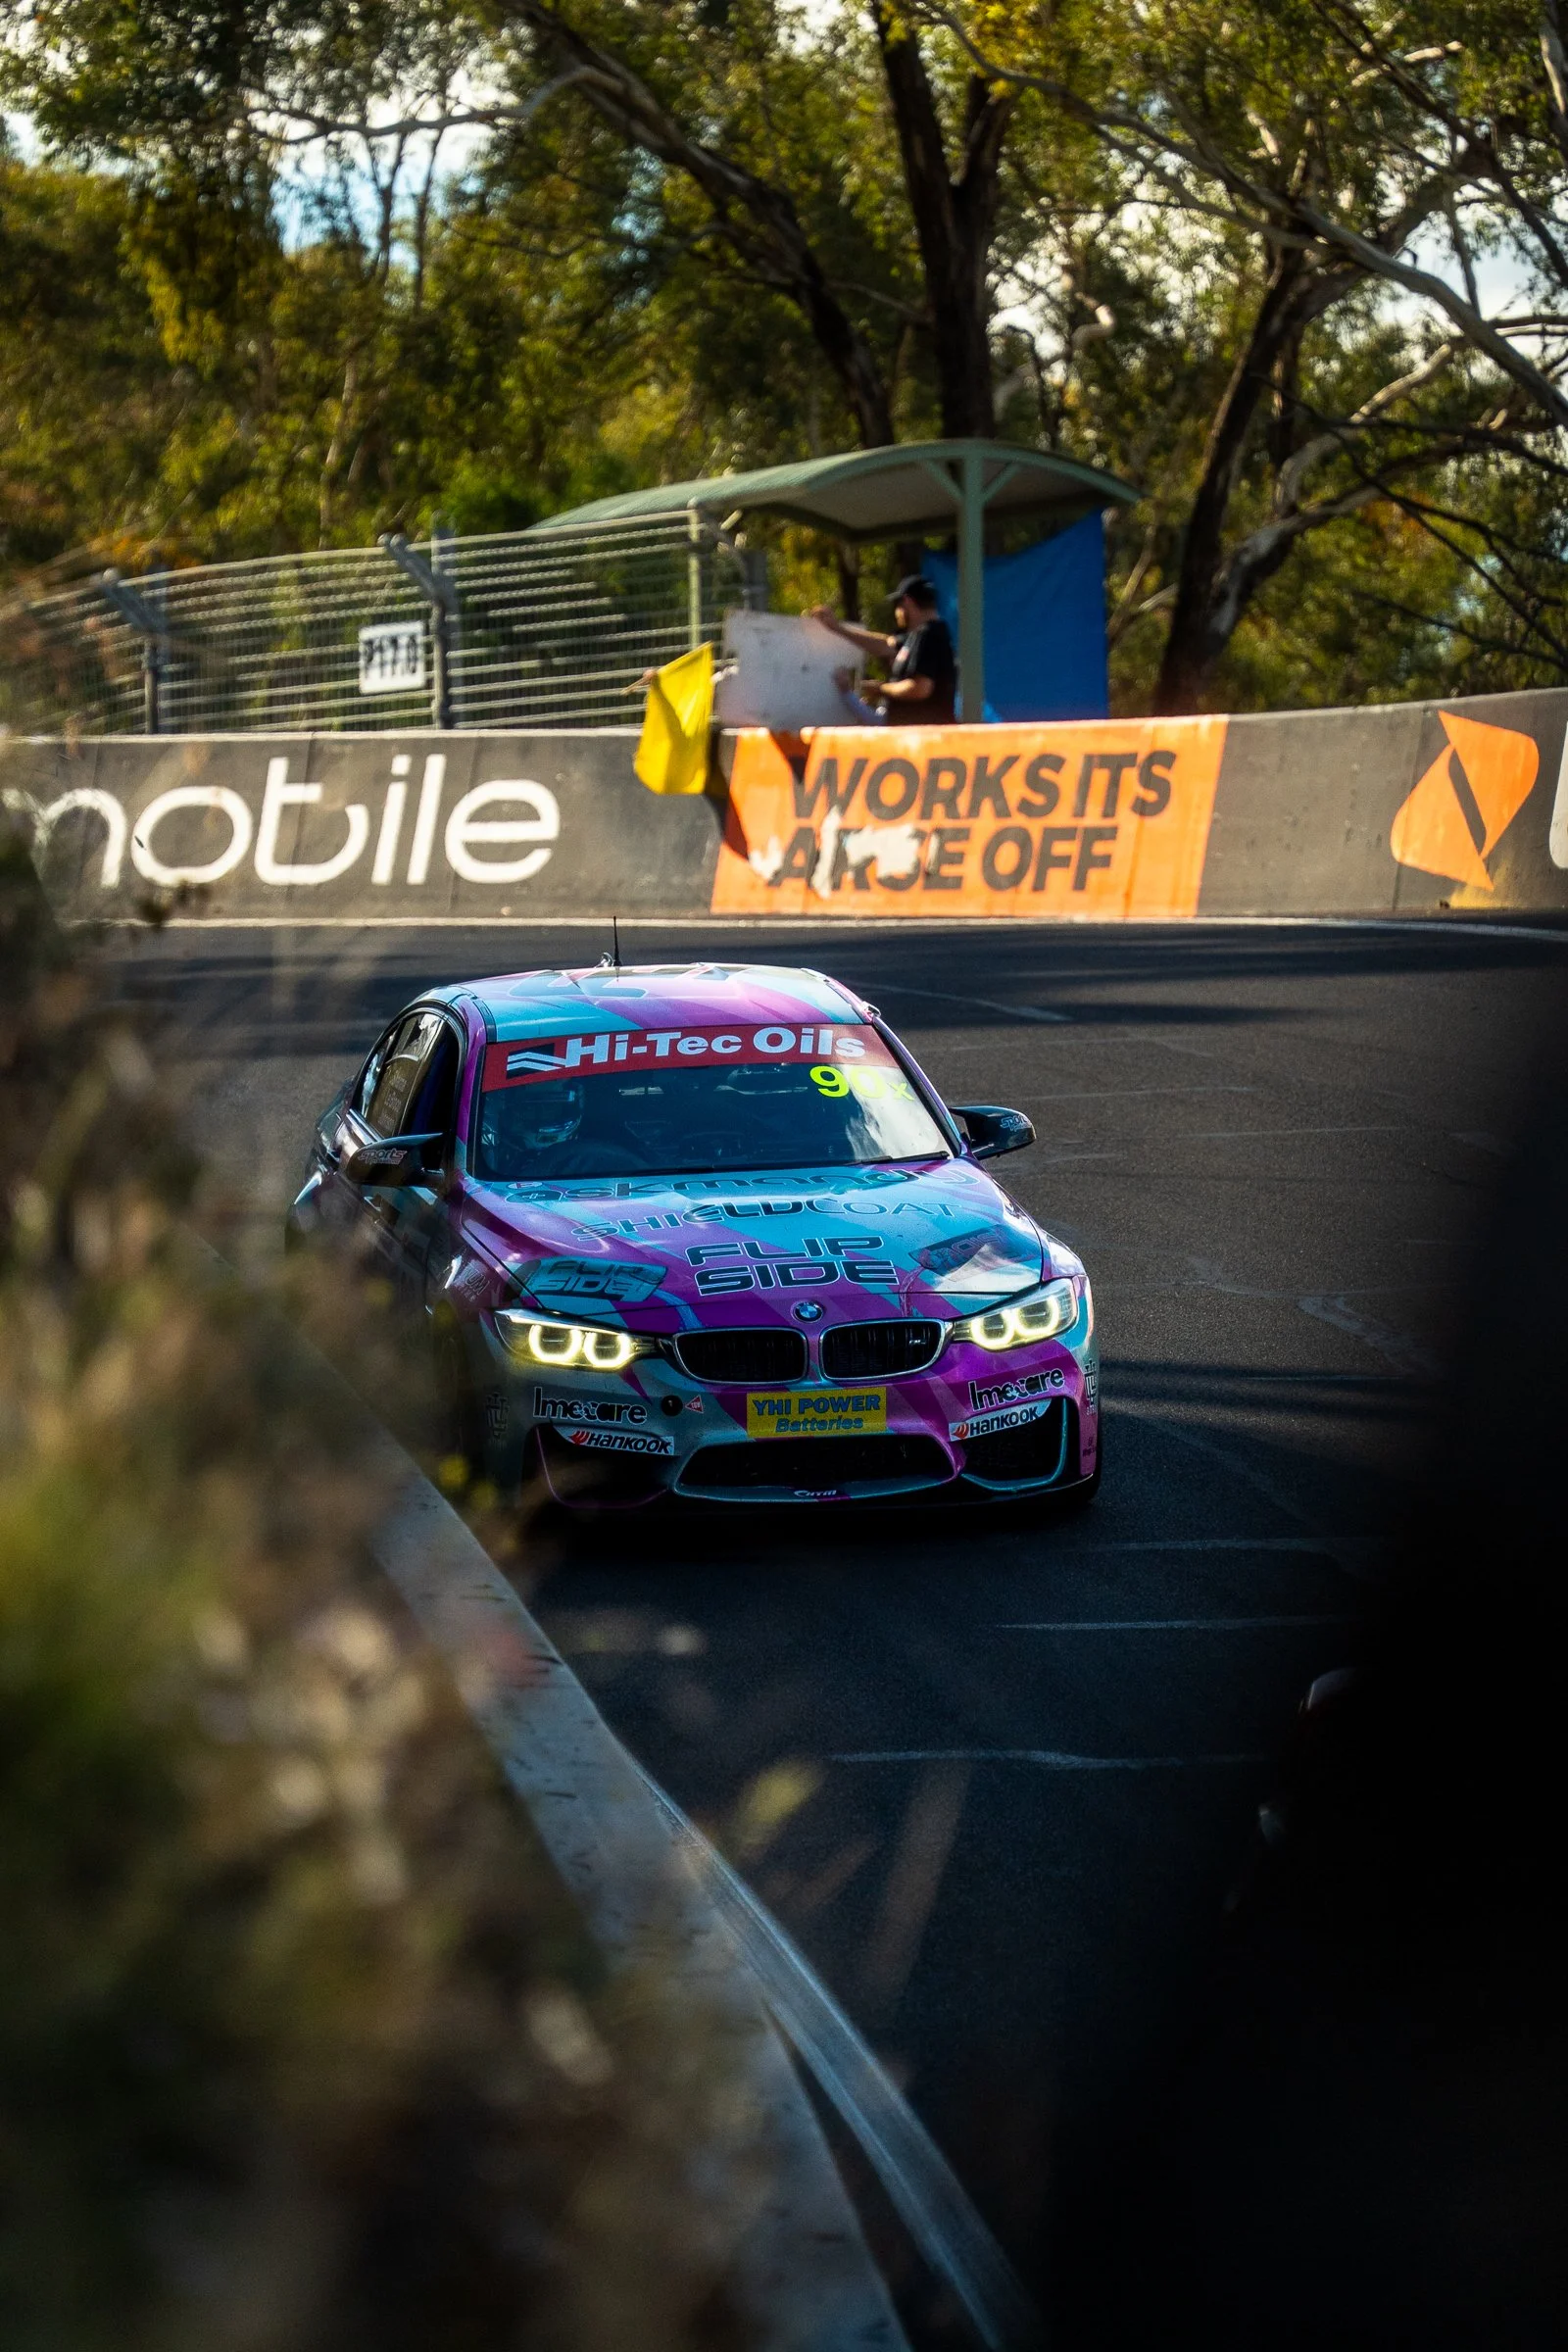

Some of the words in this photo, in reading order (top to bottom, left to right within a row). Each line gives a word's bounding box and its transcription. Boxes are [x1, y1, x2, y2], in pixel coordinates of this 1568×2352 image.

[790, 754, 1068, 820] WORKS
[1072, 751, 1178, 820] ITS
[981, 826, 1118, 892] OFF
[564, 1031, 743, 1068] Hi-Tec
[753, 1026, 866, 1058] Oils
[685, 1236, 884, 1267] FLIP
[695, 1260, 900, 1296] SIDE
[752, 1398, 792, 1416] YHI
[799, 1395, 881, 1415] POWER
[775, 1415, 864, 1433] Batteries
